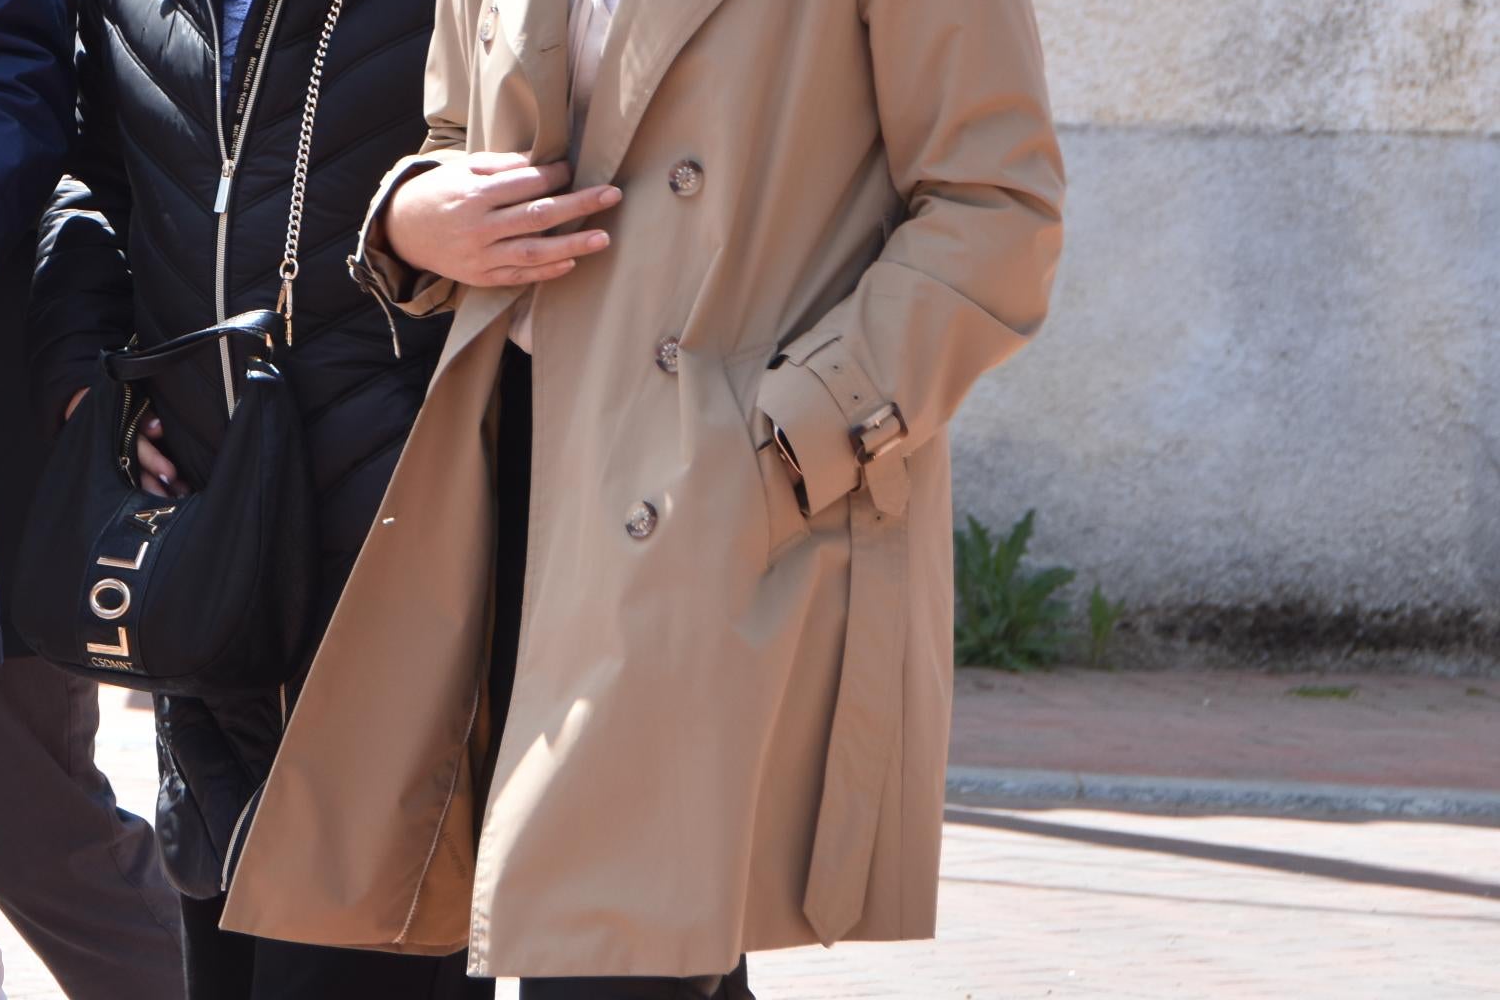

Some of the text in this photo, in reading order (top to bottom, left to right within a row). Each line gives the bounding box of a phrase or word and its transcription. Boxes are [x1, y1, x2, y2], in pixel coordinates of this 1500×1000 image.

[236, 91, 249, 114] KORS
[86, 506, 176, 656] LOLA
[91, 656, 134, 671] CSDMNT
